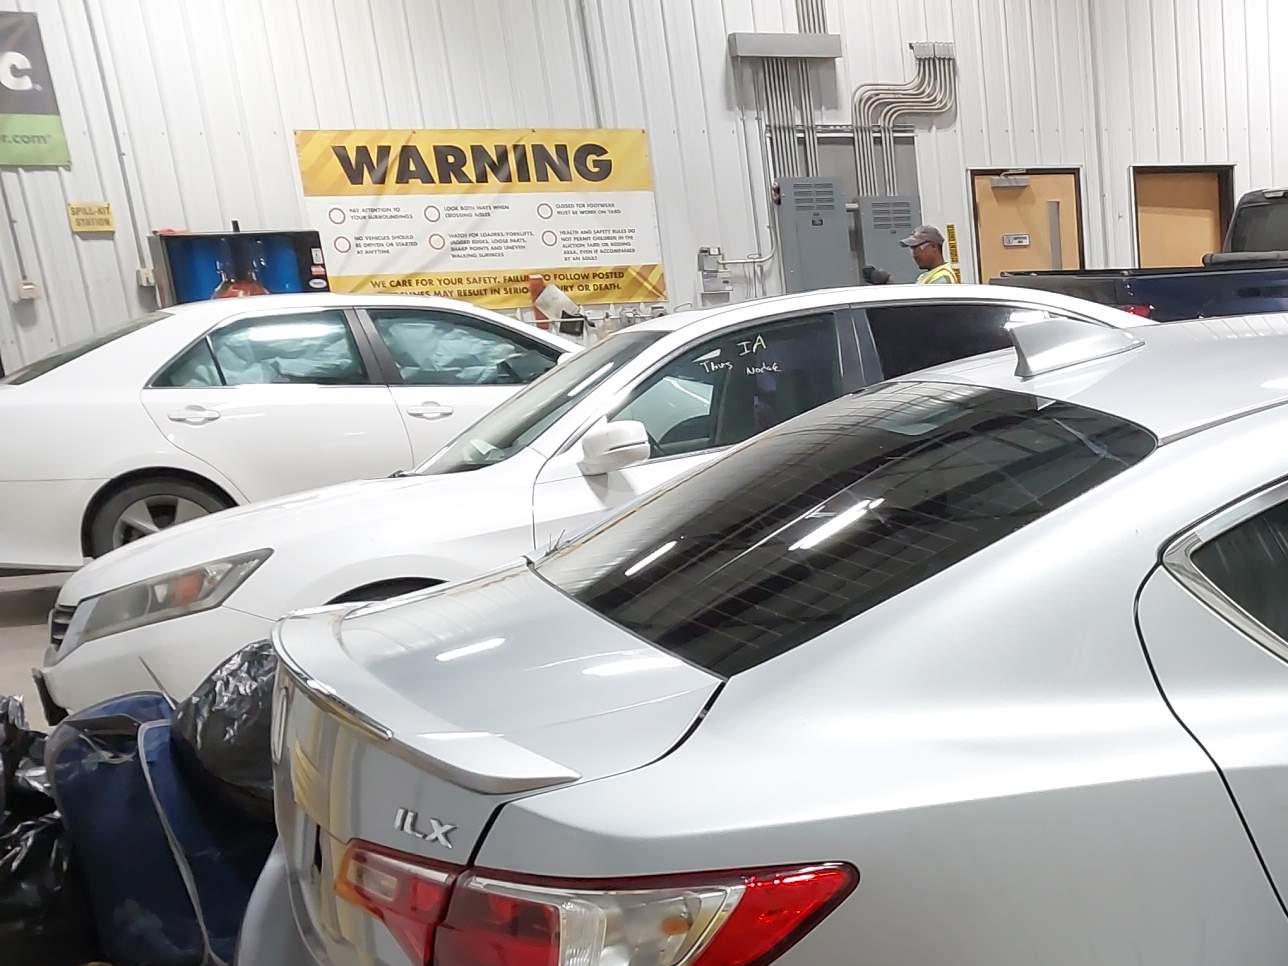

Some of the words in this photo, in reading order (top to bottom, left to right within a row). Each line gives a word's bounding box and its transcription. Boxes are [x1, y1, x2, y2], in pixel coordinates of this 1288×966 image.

[332, 143, 613, 185] WARNING
[370, 280, 387, 288] WE
[389, 279, 413, 288] CARE
[415, 278, 434, 287] FOR
[436, 277, 463, 286] YOUR
[466, 276, 500, 285] SAFETY.
[503, 275, 529, 283] FAILU
[553, 272, 590, 281] FOLLOW
[592, 271, 625, 280] POSTED
[434, 290, 454, 298] MAY
[456, 288, 488, 297] RESULT
[490, 287, 500, 295] IN
[503, 286, 529, 295] SERIO
[577, 284, 590, 292] OR
[736, 334, 766, 356] IA
[394, 807, 457, 849] ILX
